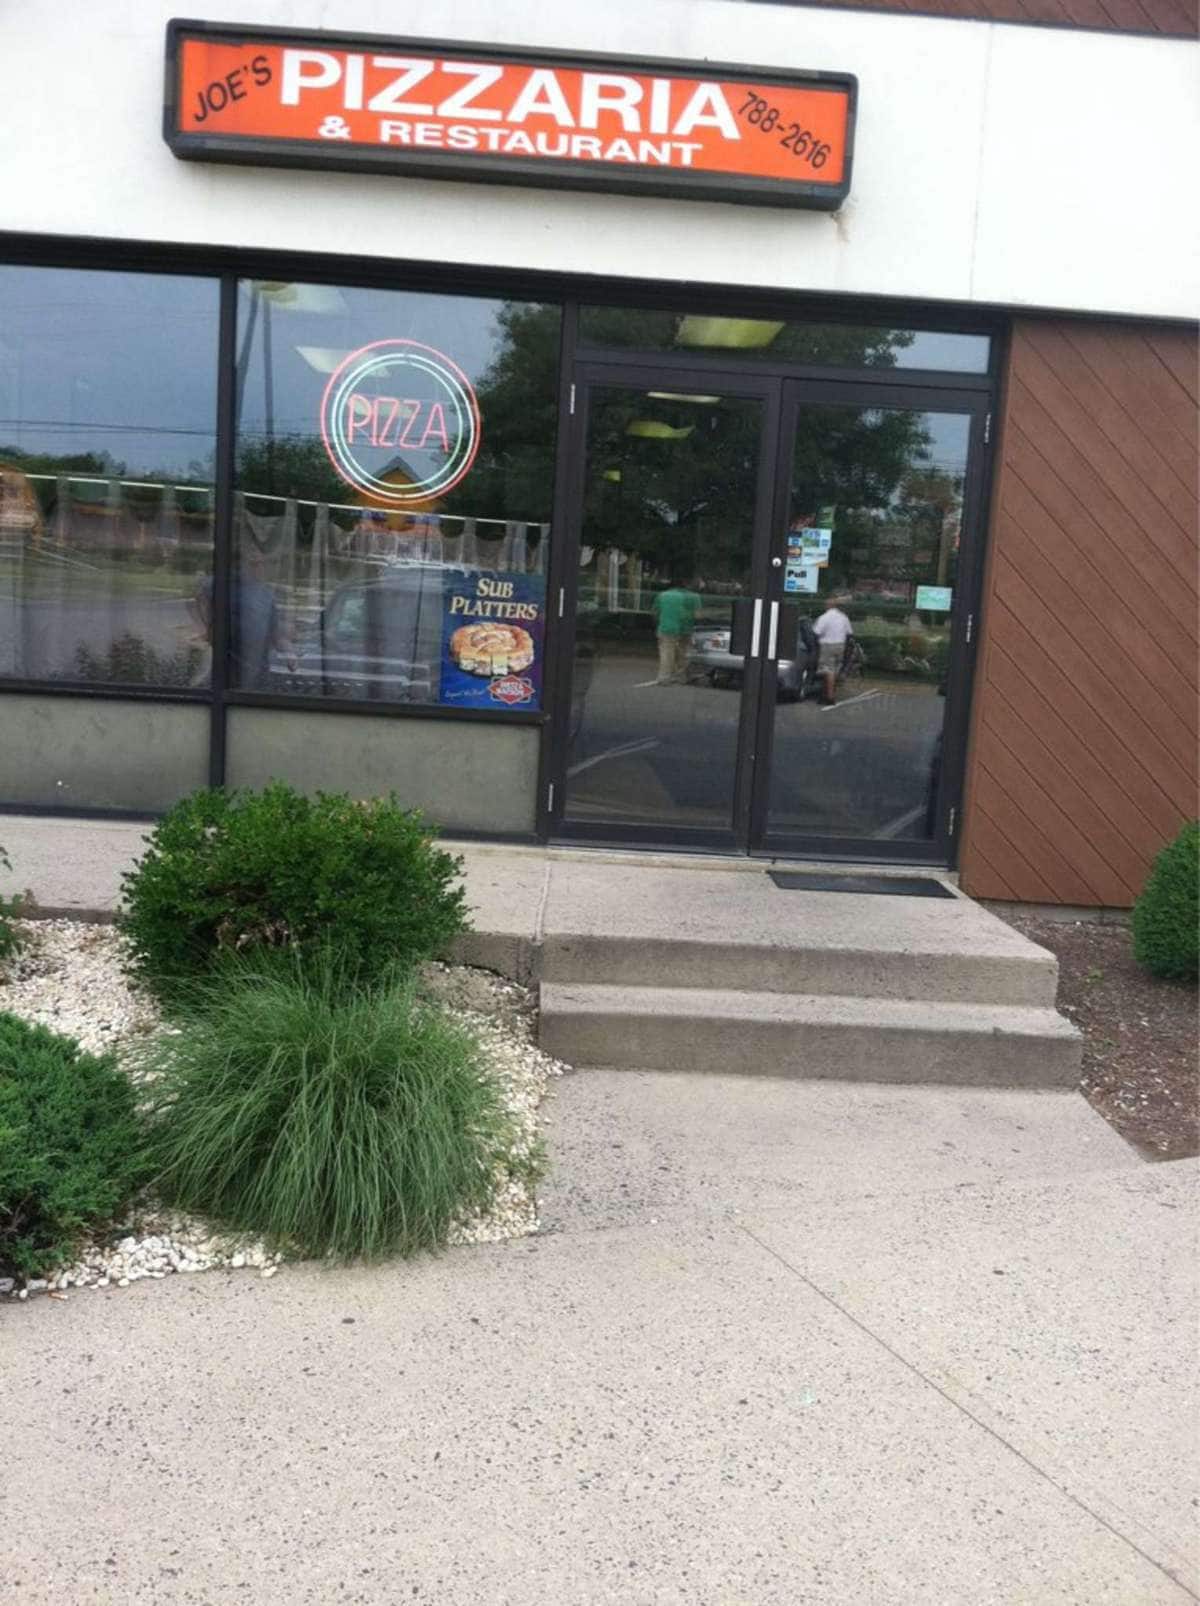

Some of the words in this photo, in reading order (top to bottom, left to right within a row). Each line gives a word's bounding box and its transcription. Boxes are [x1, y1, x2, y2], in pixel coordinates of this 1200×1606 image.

[193, 55, 273, 122] JOE'S
[280, 49, 741, 139] PIZZARIA
[317, 115, 351, 139] &
[378, 120, 703, 166] RESTAURANT
[737, 91, 831, 169] 788-2616
[347, 393, 449, 453] PIZZA
[449, 596, 539, 620] PLATTERS
[476, 578, 514, 598] SUB
